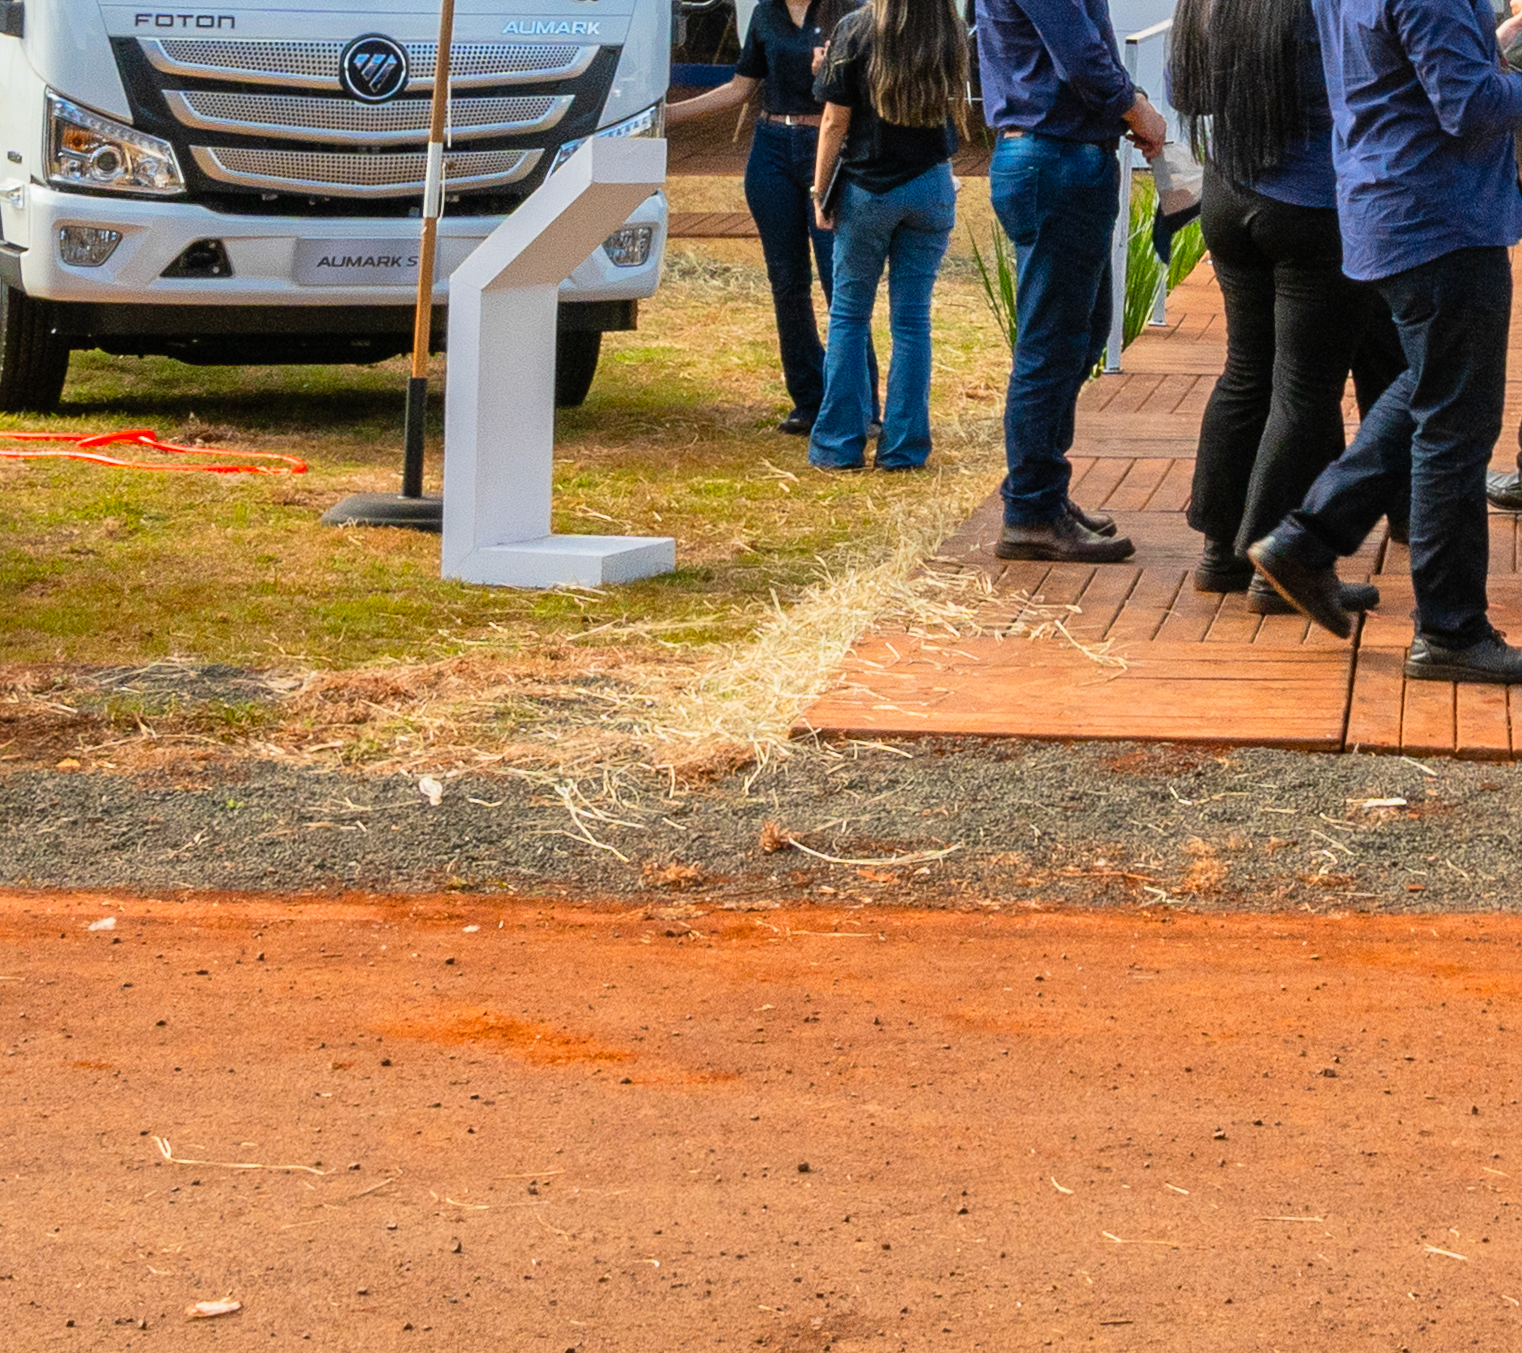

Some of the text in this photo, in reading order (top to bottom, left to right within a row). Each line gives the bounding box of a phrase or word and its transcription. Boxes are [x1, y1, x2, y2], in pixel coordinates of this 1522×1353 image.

[134, 13, 236, 29] FOTON
[502, 20, 601, 36] AUMARK
[316, 255, 419, 268] AUMARK S
